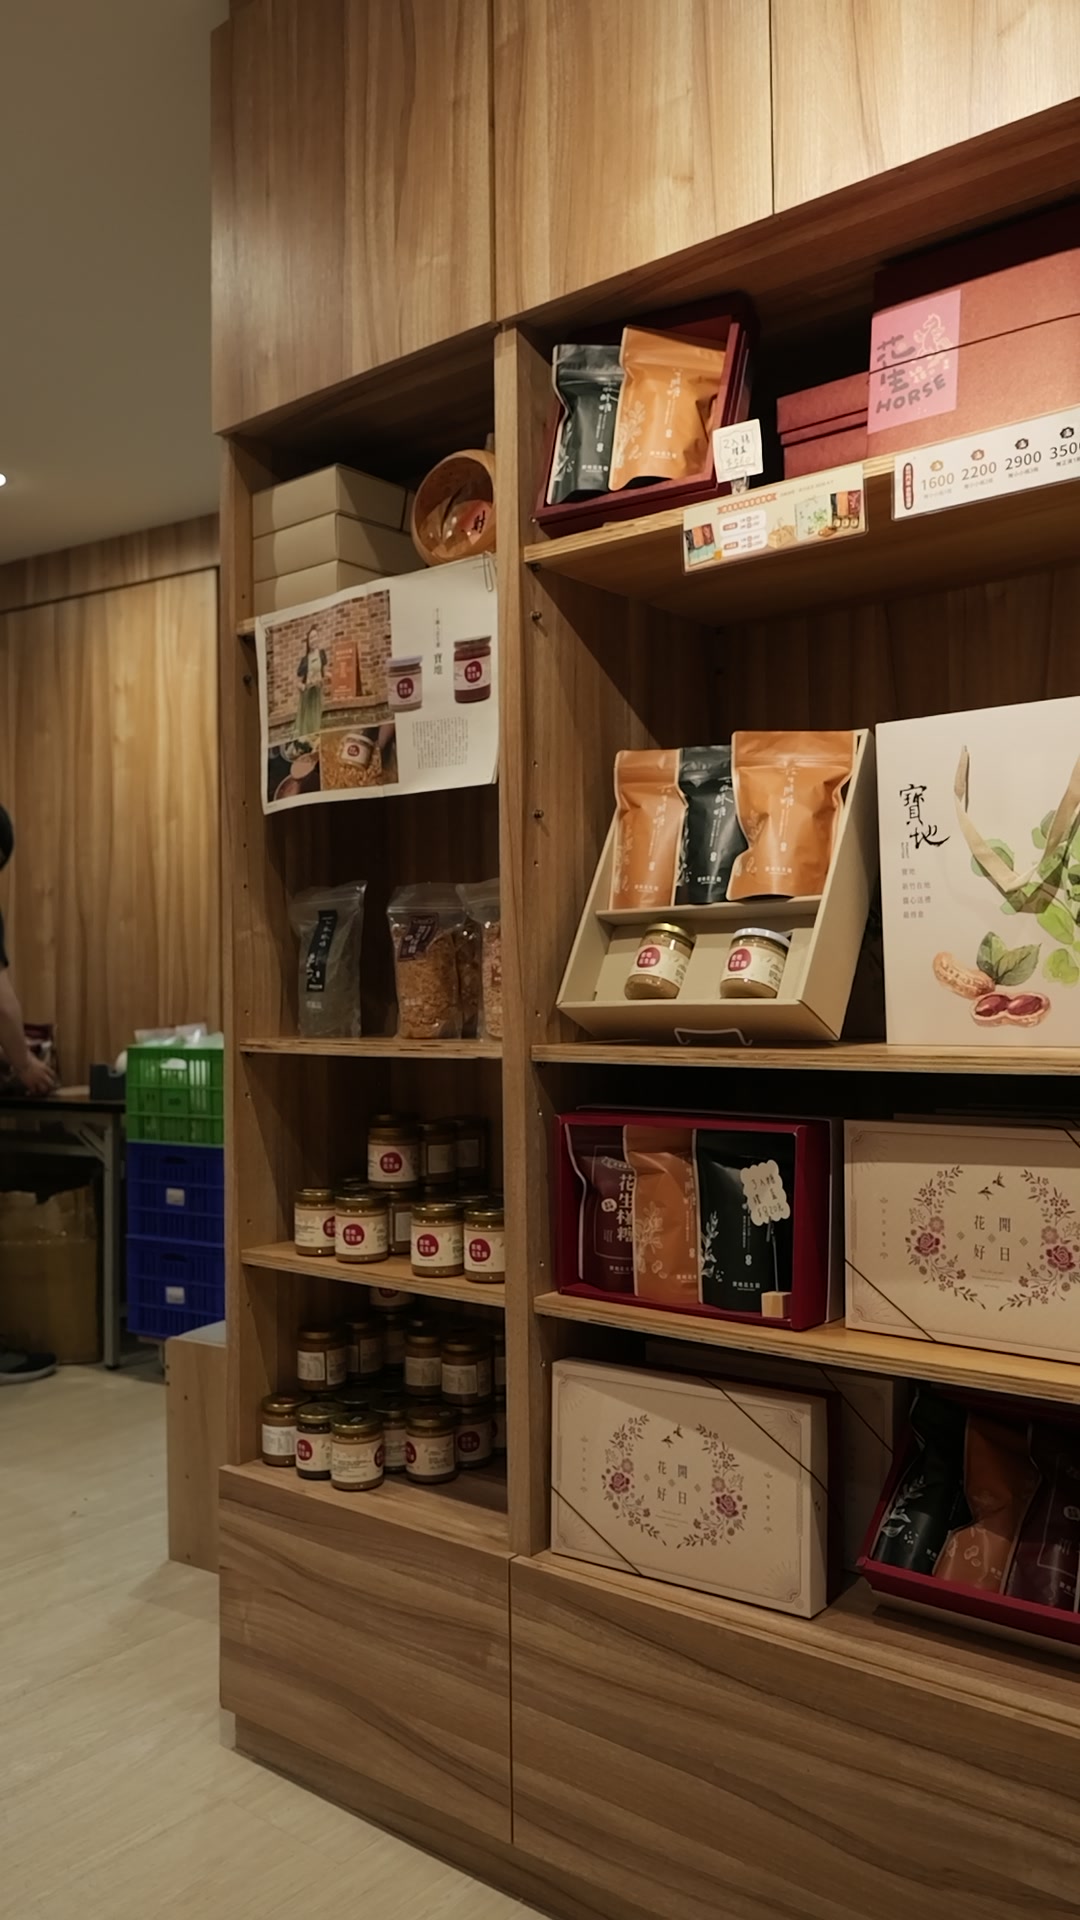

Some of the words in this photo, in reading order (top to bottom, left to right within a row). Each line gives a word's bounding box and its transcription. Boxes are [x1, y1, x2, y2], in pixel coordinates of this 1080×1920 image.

[876, 373, 947, 414] HORSE
[921, 472, 955, 491] 1600
[961, 461, 997, 481] 2200
[1005, 451, 1042, 471] 2900
[1049, 442, 1080, 460] 350
[899, 784, 950, 849] 寶地
[973, 1215, 1012, 1233] 花開
[973, 1244, 1011, 1263] 好日
[657, 1460, 688, 1479] 花開
[656, 1487, 688, 1505] 好日
